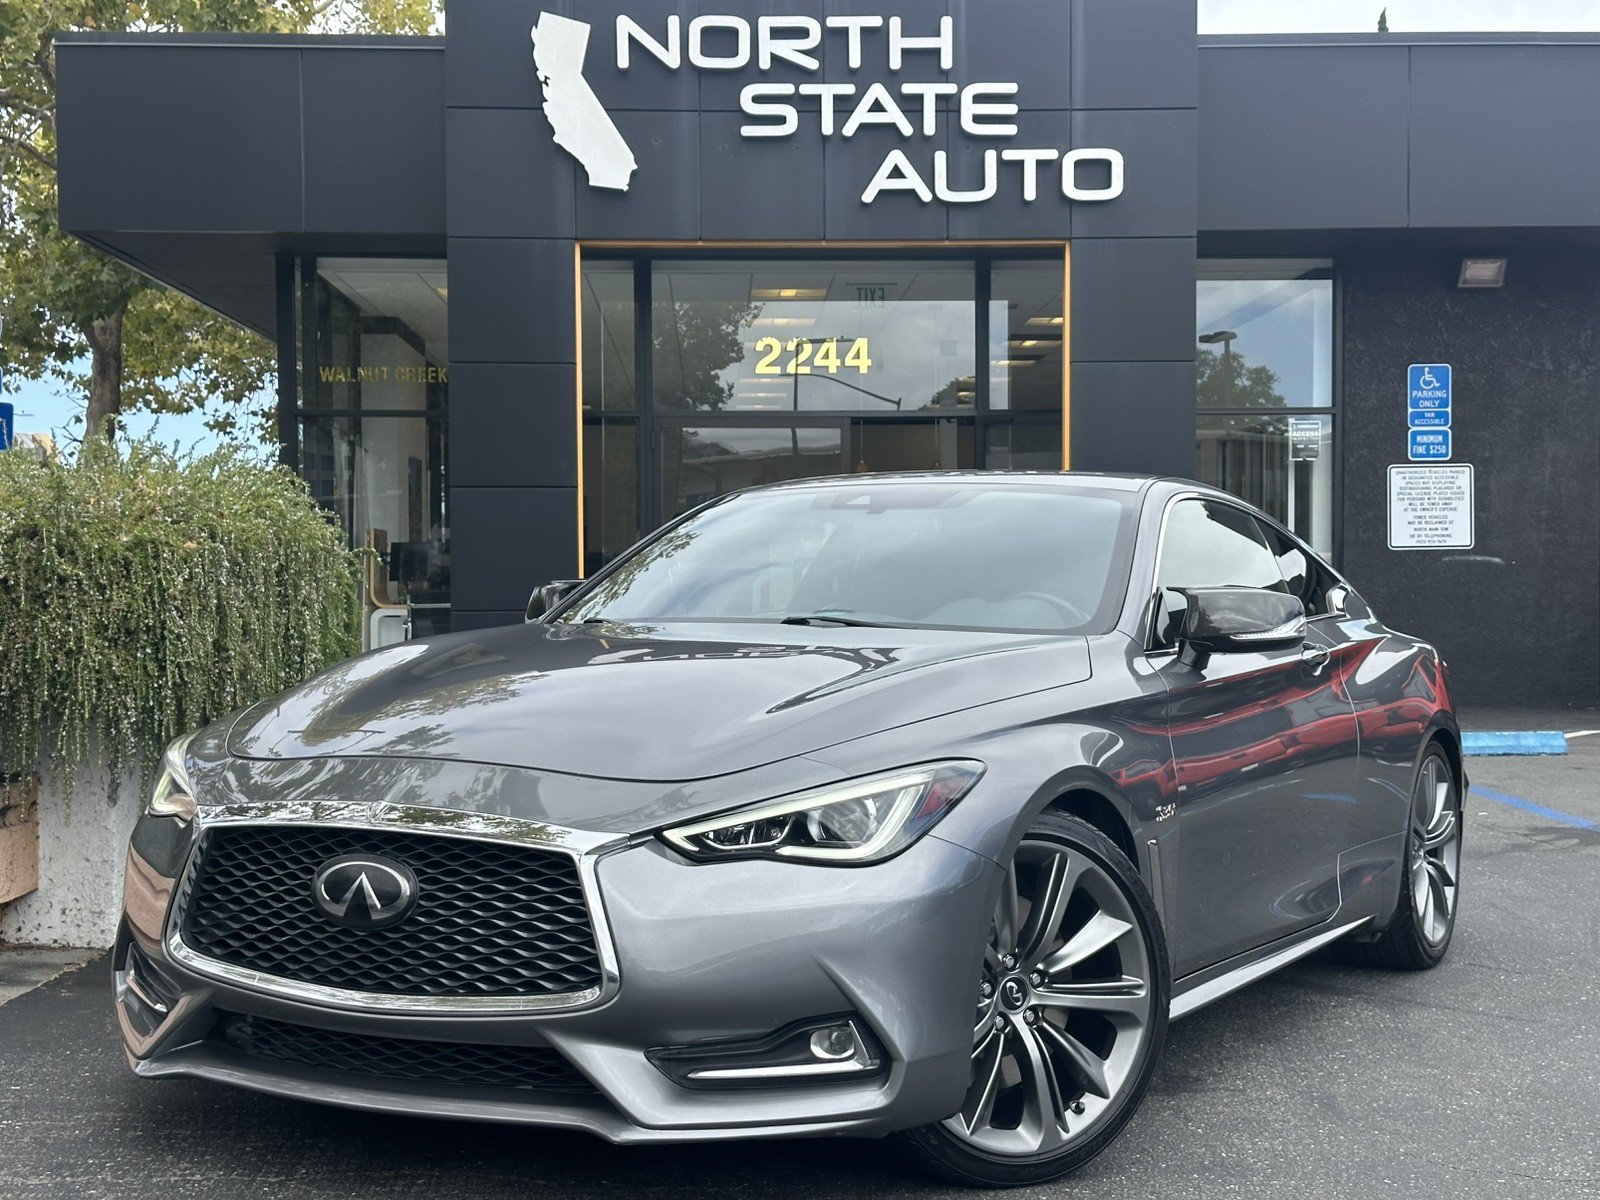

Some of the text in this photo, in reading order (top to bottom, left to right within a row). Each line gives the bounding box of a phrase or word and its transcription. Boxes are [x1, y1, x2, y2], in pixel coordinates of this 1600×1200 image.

[616, 14, 954, 71] NORTH
[739, 81, 1019, 138] STATE
[861, 147, 1125, 204] AUTO
[754, 336, 872, 375] 2244
[319, 365, 448, 383] WALNUT CREEK
[1412, 390, 1448, 398] PARKING
[1419, 400, 1440, 408] ONLY
[1416, 434, 1443, 443] MINIMUM
[1412, 444, 1447, 455] FINE $250
